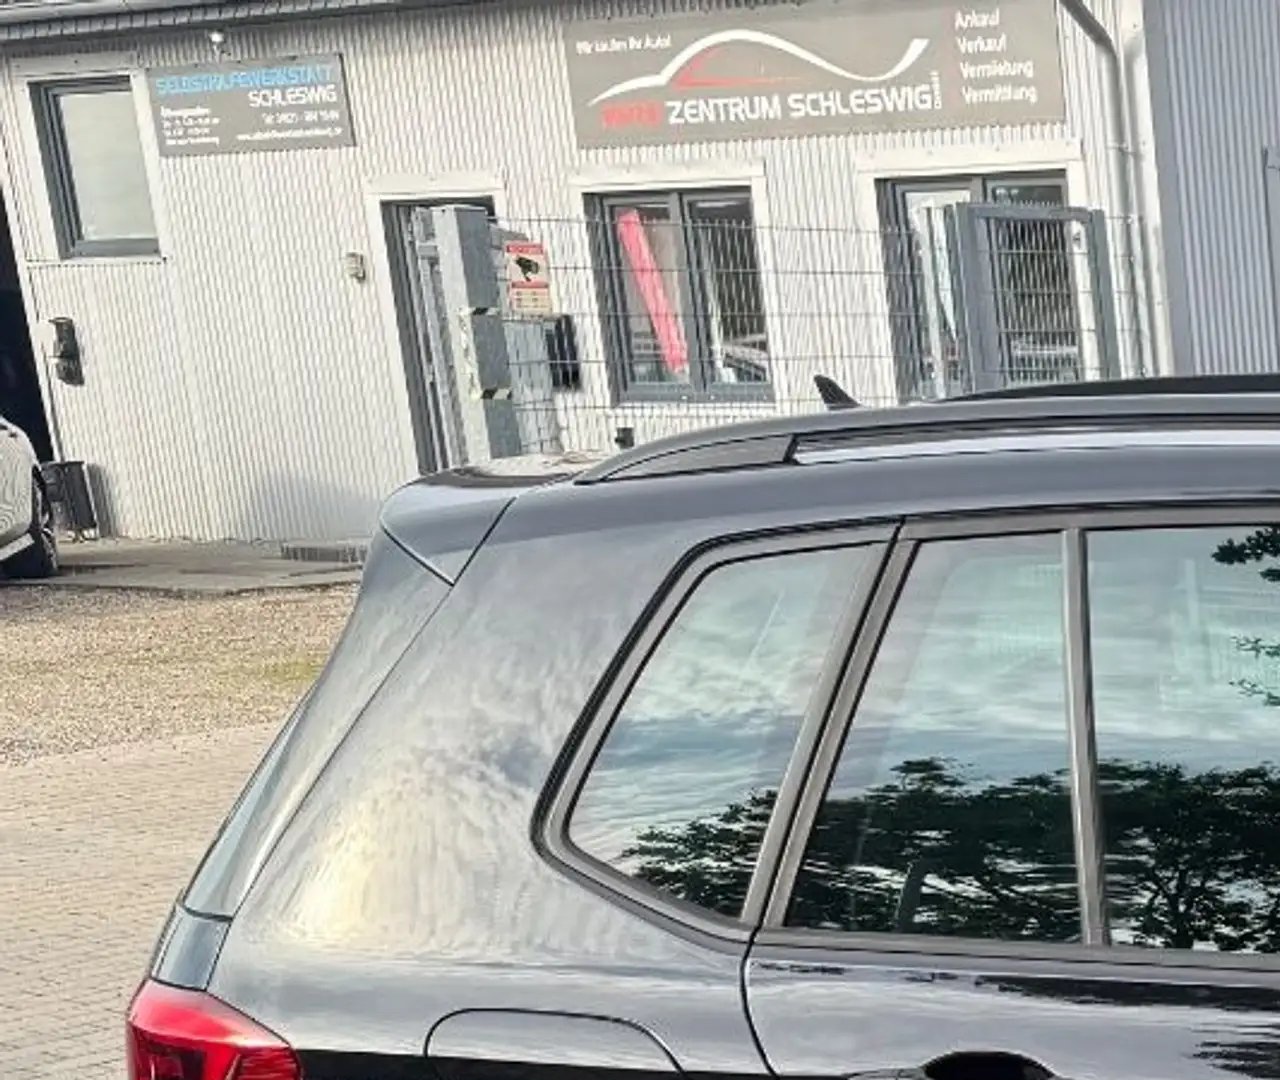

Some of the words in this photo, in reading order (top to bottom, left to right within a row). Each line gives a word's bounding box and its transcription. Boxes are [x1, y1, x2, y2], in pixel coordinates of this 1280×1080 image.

[956, 33, 1007, 54] Verkauf
[960, 59, 1034, 80] Vermietung
[247, 84, 337, 108] SCHLESWIG
[665, 94, 781, 125] ZENTRUM
[787, 84, 932, 117] SCHLESWIG
[961, 84, 1038, 104] Vermittlung
